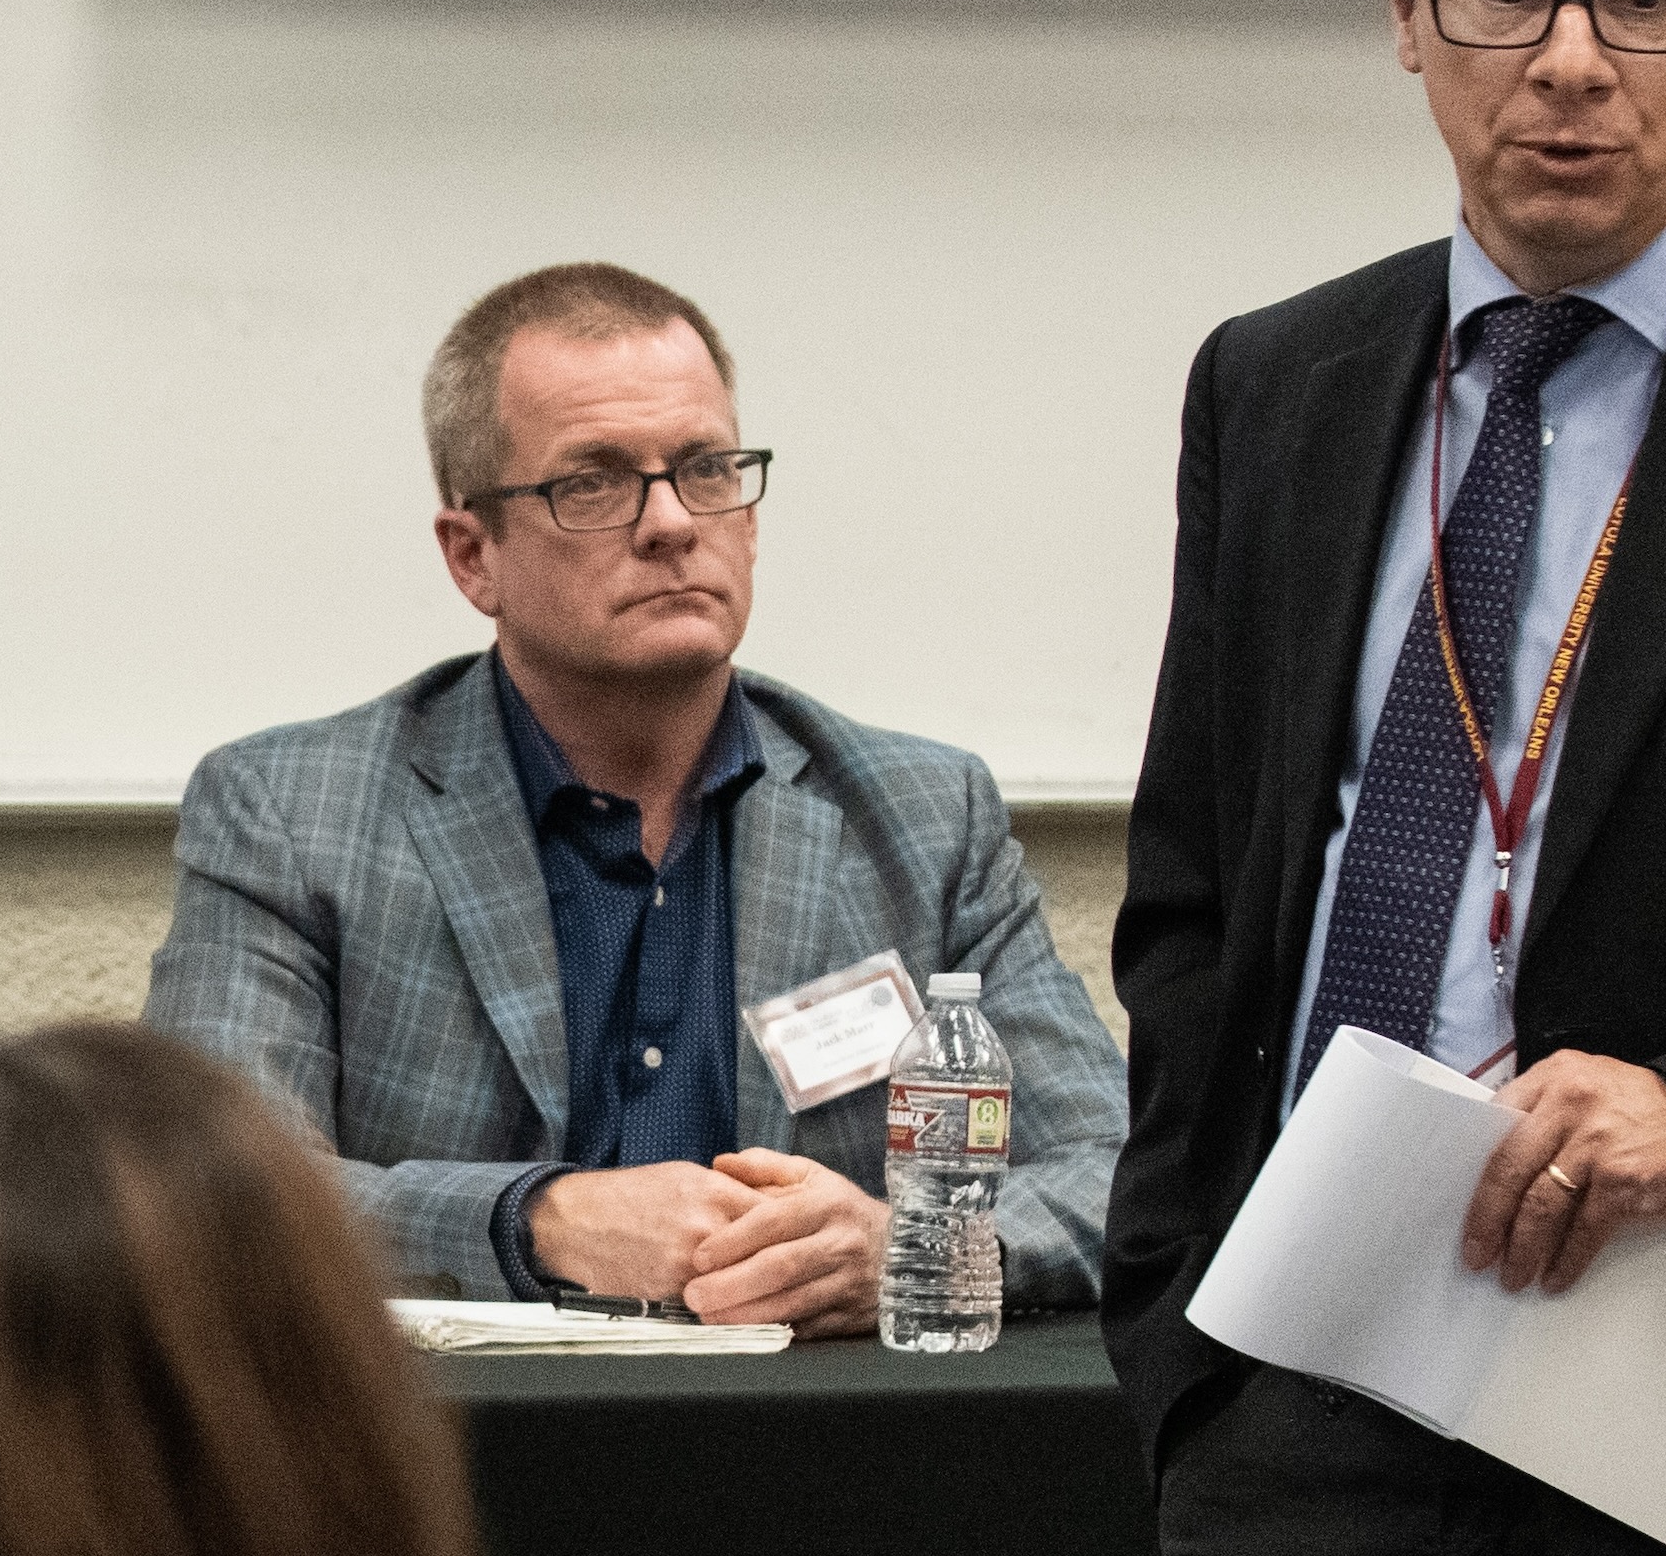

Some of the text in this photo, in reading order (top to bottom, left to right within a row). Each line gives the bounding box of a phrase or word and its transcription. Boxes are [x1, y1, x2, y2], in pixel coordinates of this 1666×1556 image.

[1564, 558, 1610, 646] UNIVERSITY
[1550, 647, 1575, 684] NEW
[1525, 685, 1561, 760] ORLEANS
